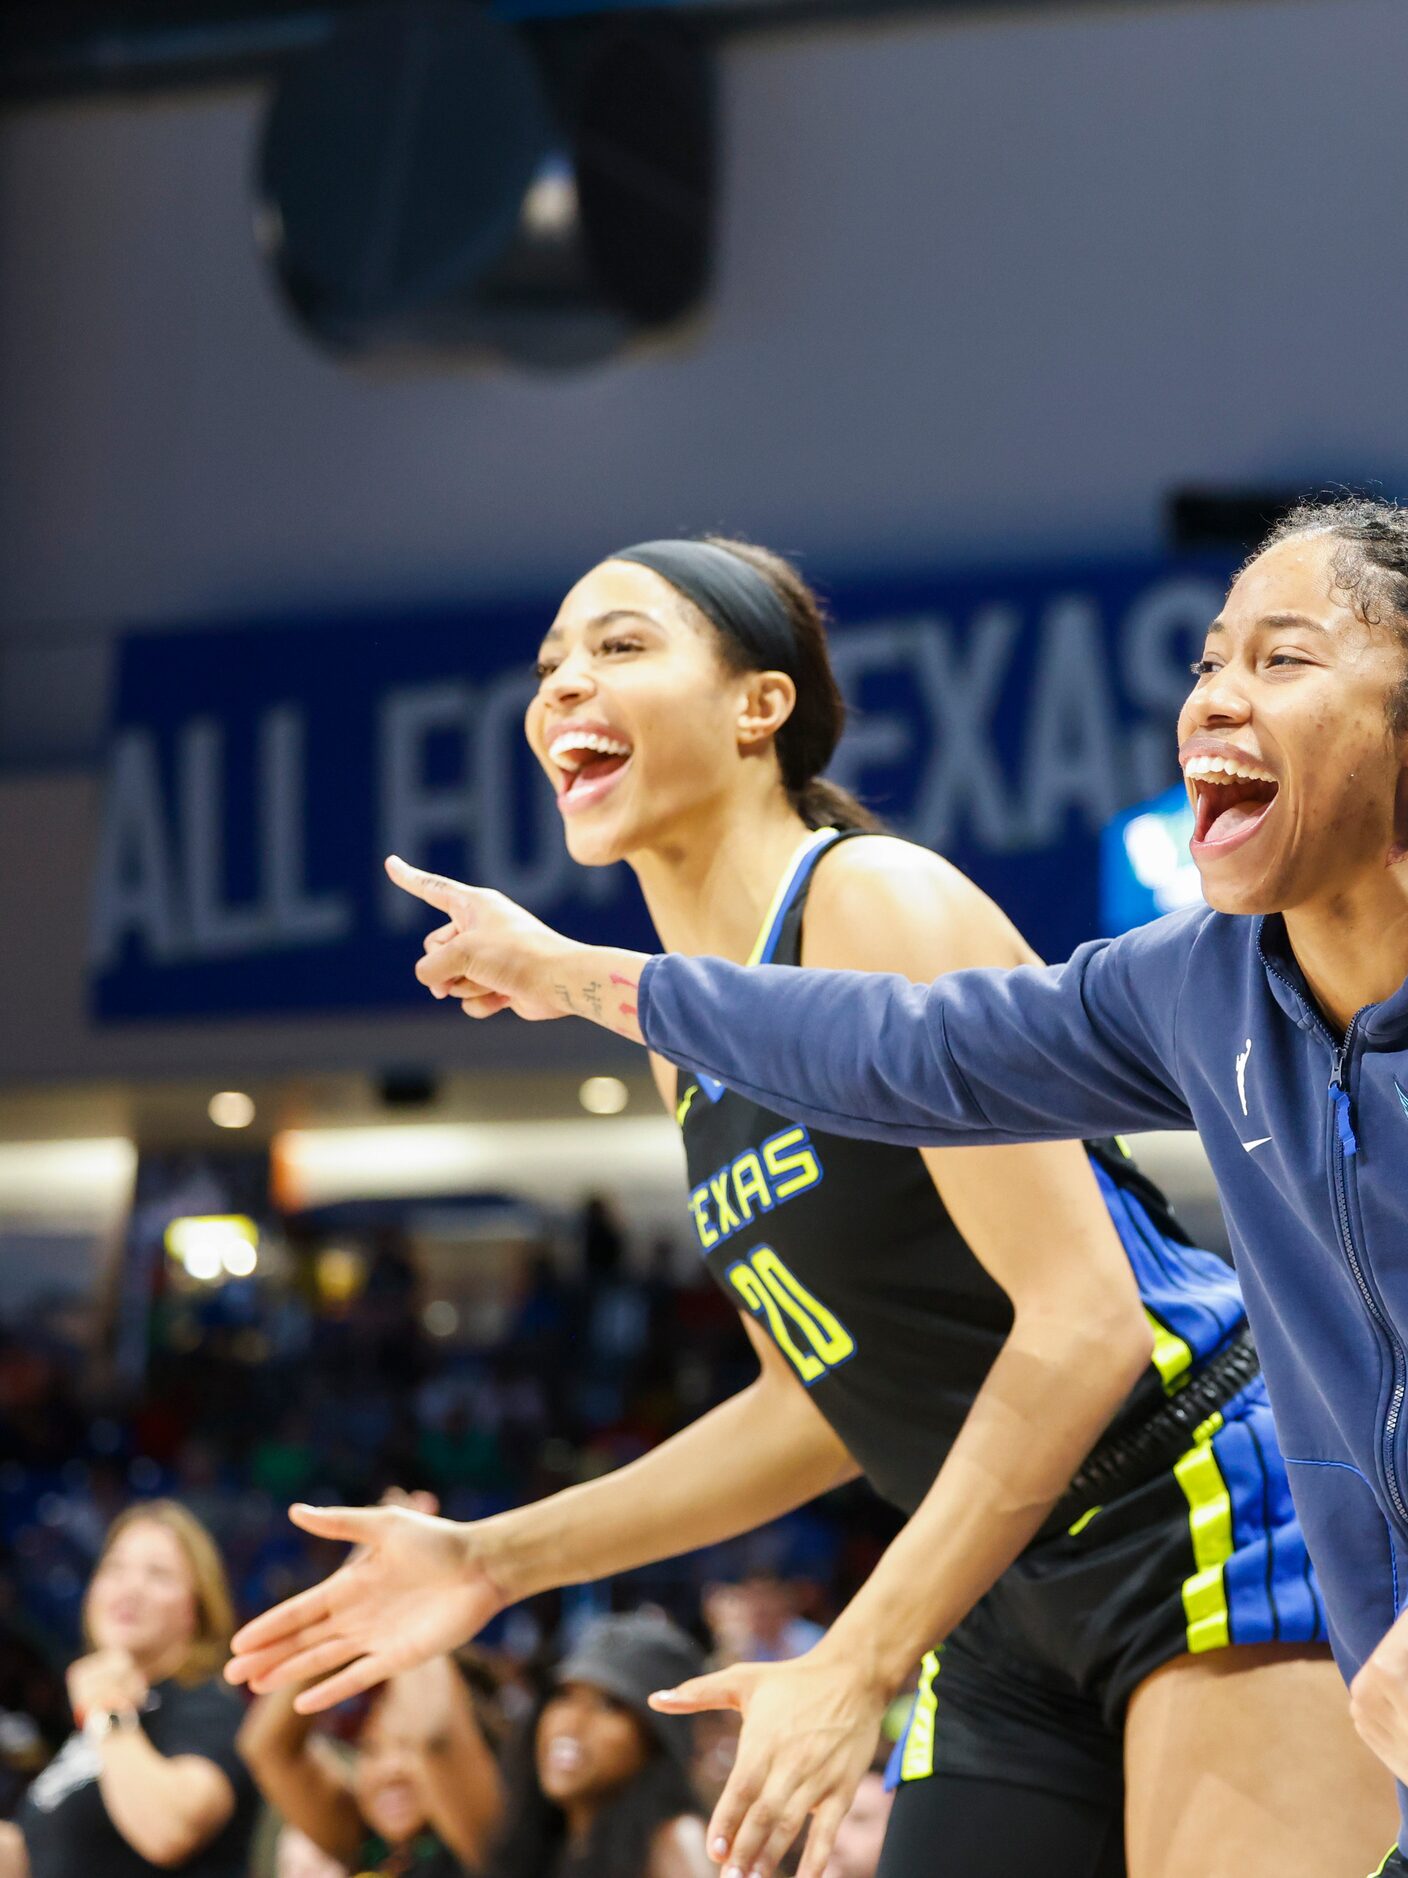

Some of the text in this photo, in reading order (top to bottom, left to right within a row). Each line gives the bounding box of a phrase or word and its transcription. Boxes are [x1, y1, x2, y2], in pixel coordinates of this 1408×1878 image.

[88, 575, 1224, 972] ALL FO EXAS
[688, 1125, 821, 1252] EXAS
[728, 1244, 855, 1384] 20
